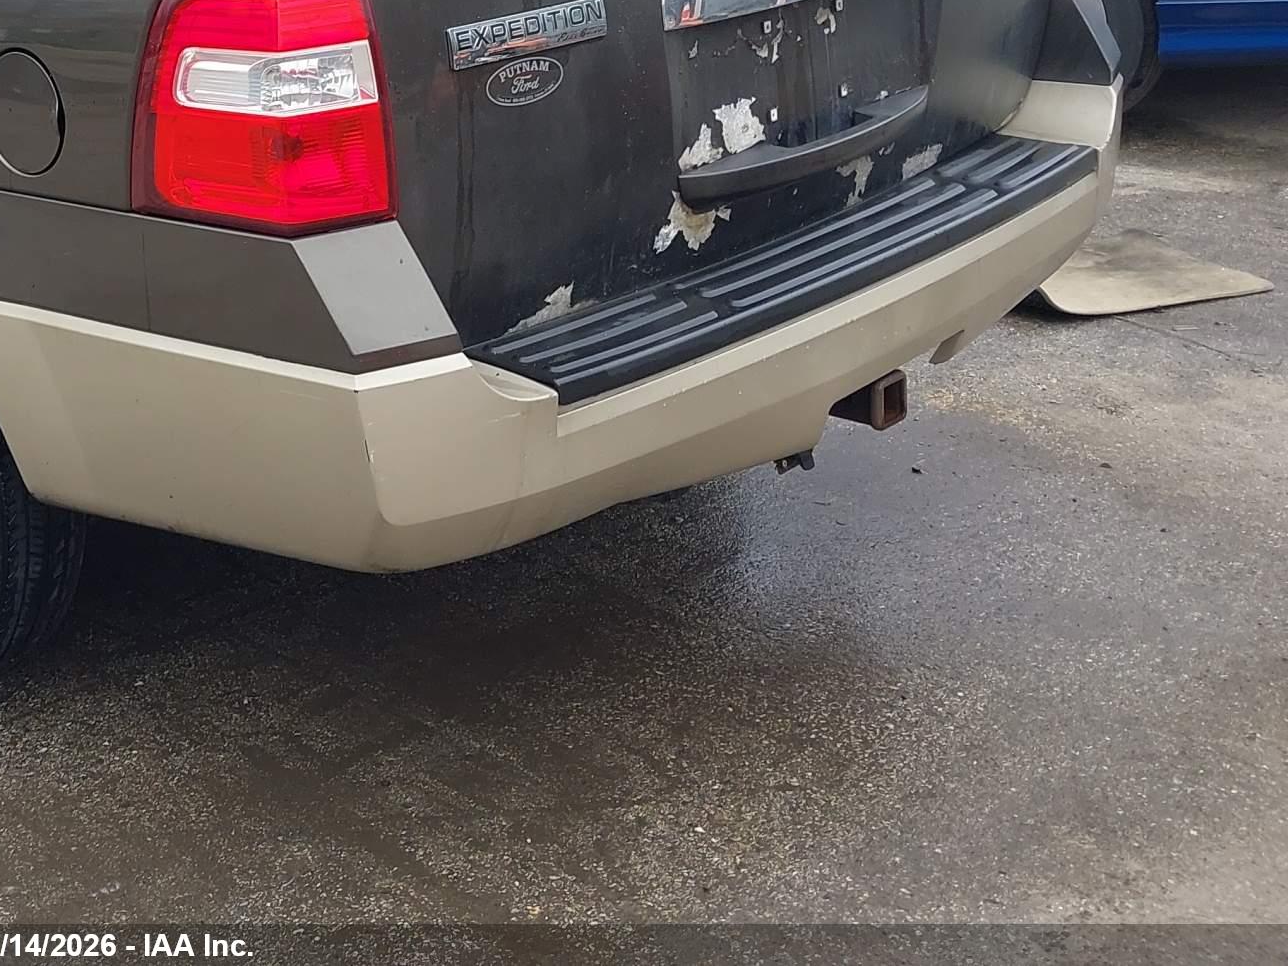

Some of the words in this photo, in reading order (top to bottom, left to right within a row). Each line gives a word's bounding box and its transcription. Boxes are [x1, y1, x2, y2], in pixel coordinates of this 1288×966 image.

[455, 0, 603, 51] EXPEDITION
[499, 60, 551, 83] PUTNAM
[511, 74, 540, 94] Ford
